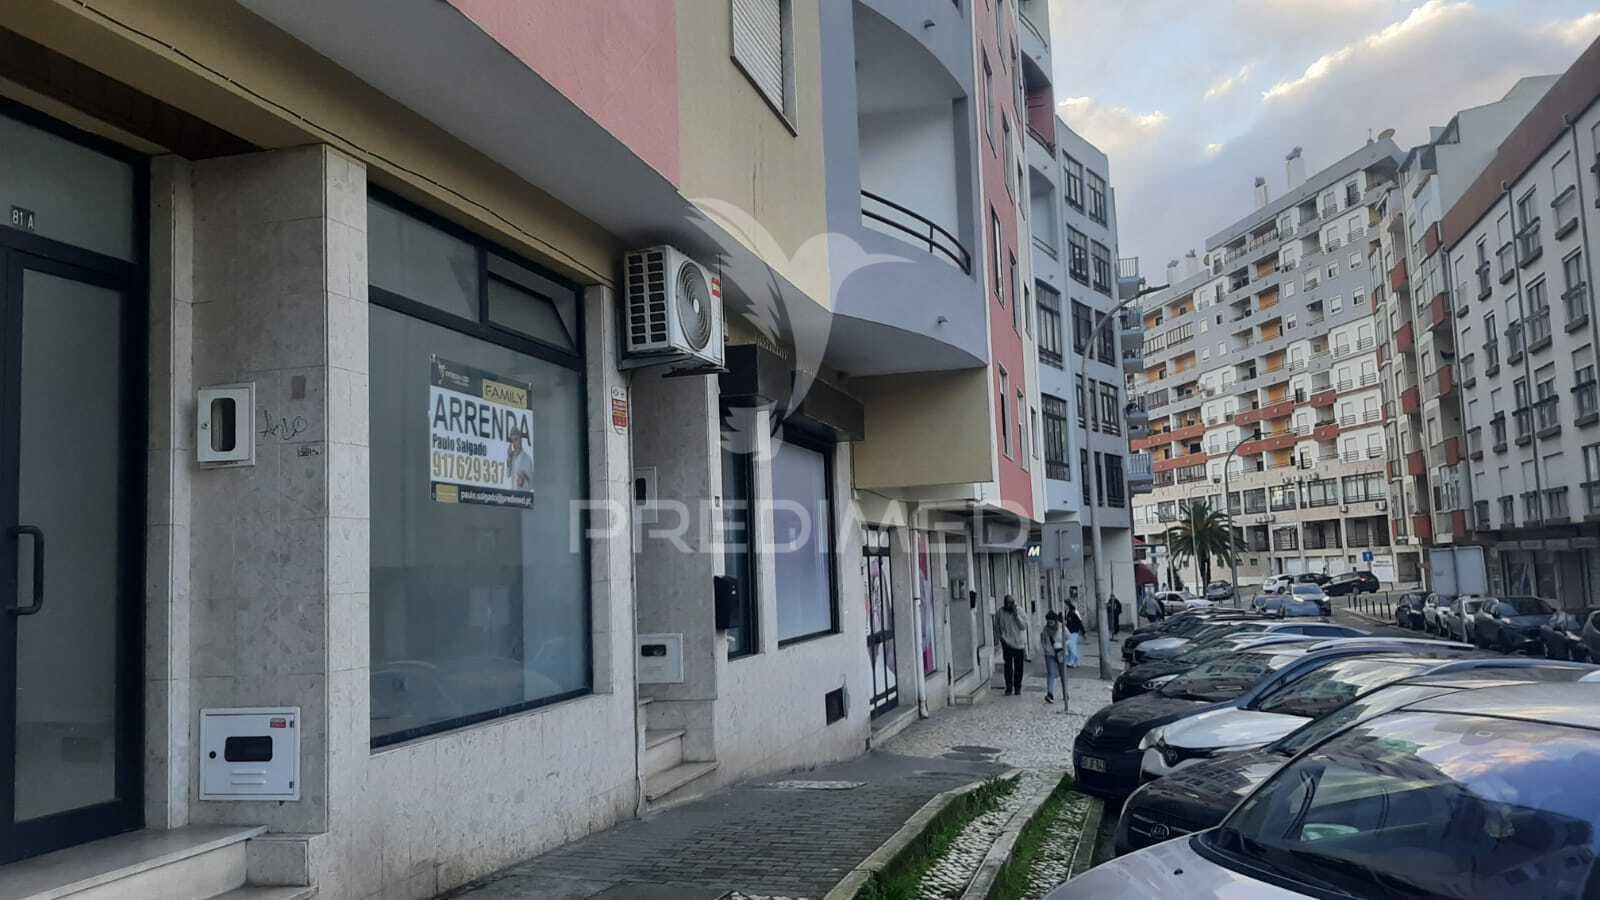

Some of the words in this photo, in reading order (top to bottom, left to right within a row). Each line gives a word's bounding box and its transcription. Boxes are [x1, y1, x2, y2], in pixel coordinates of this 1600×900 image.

[12, 209, 23, 225] 81
[28, 214, 34, 230] A
[485, 384, 527, 405] FAMILY
[433, 393, 531, 447] ARRENDA
[432, 432, 455, 450] Paulo
[456, 437, 487, 457] Salgado
